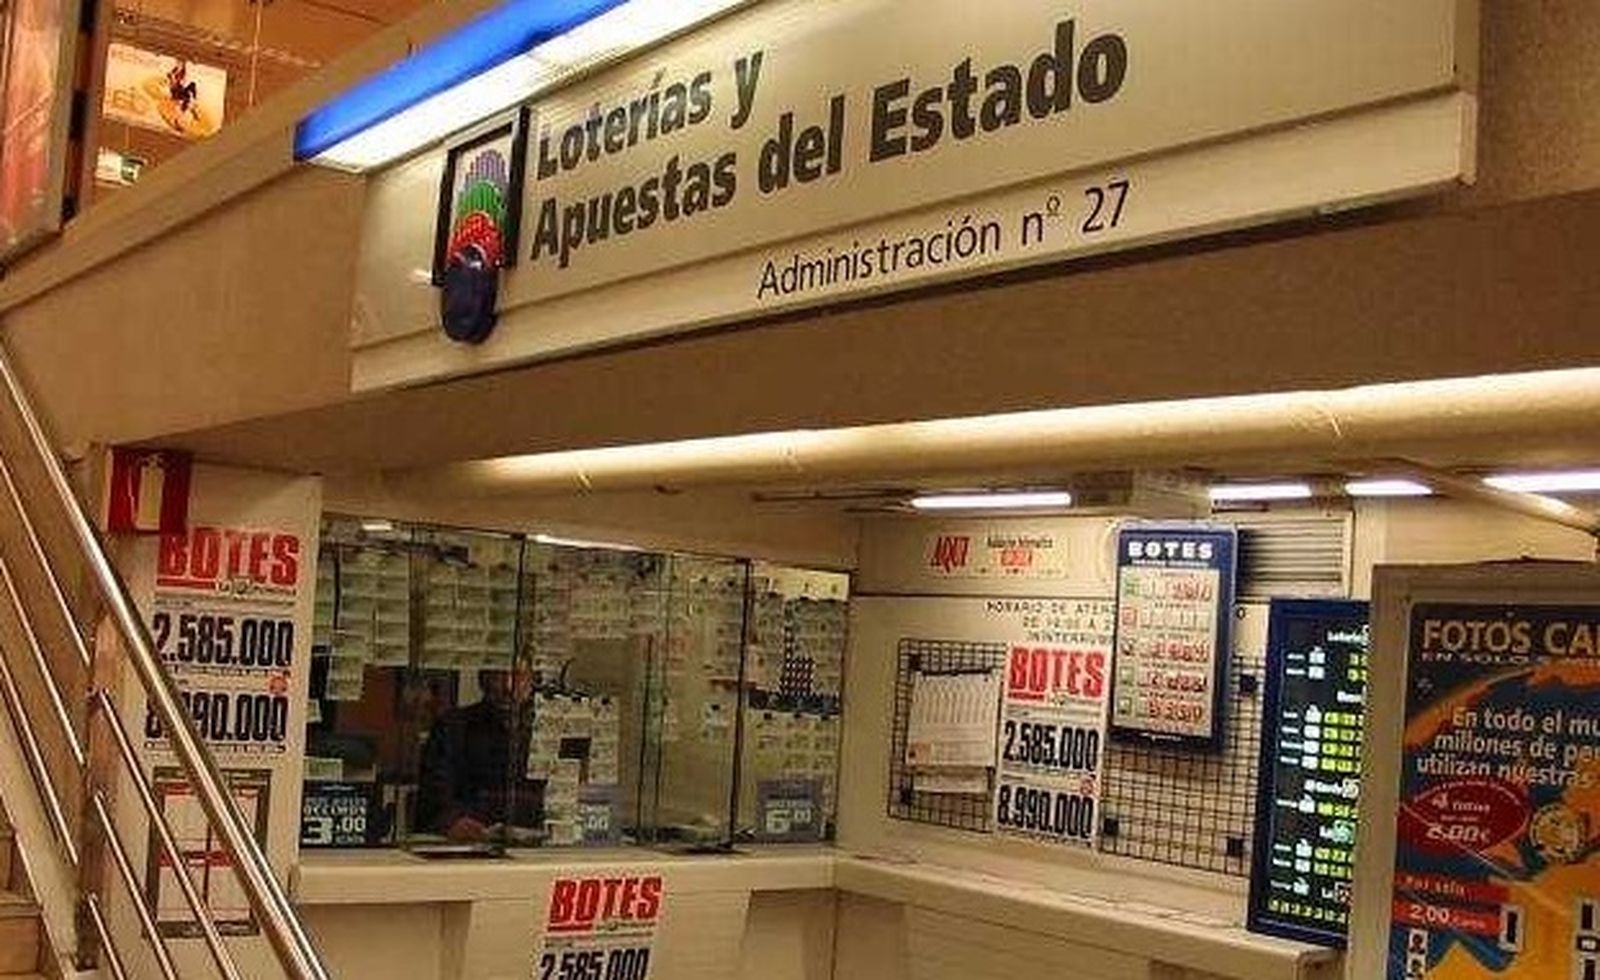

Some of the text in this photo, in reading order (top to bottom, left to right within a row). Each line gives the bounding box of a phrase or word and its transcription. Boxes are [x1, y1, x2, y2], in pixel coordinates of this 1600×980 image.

[537, 51, 763, 180] Loterías y
[531, 19, 1127, 268] Apuestas del Estado
[758, 216, 1000, 298] Administración
[1082, 181, 1129, 232] 27
[157, 526, 299, 586] BOTES
[1128, 541, 1213, 560] BOTES
[152, 612, 295, 667] 2.585.000
[1424, 619, 1600, 655] FOTOS CA
[1009, 647, 1105, 698] BOTES
[1434, 729, 1523, 758] millones
[1529, 735, 1557, 760] de
[1453, 706, 1478, 727] En
[1484, 706, 1535, 732] todo
[1541, 709, 1562, 734] el
[1003, 720, 1100, 772] 2.585.000
[1416, 752, 1491, 777] utilizan
[997, 784, 1094, 839] 8.990.000
[549, 877, 662, 923] BOTES
